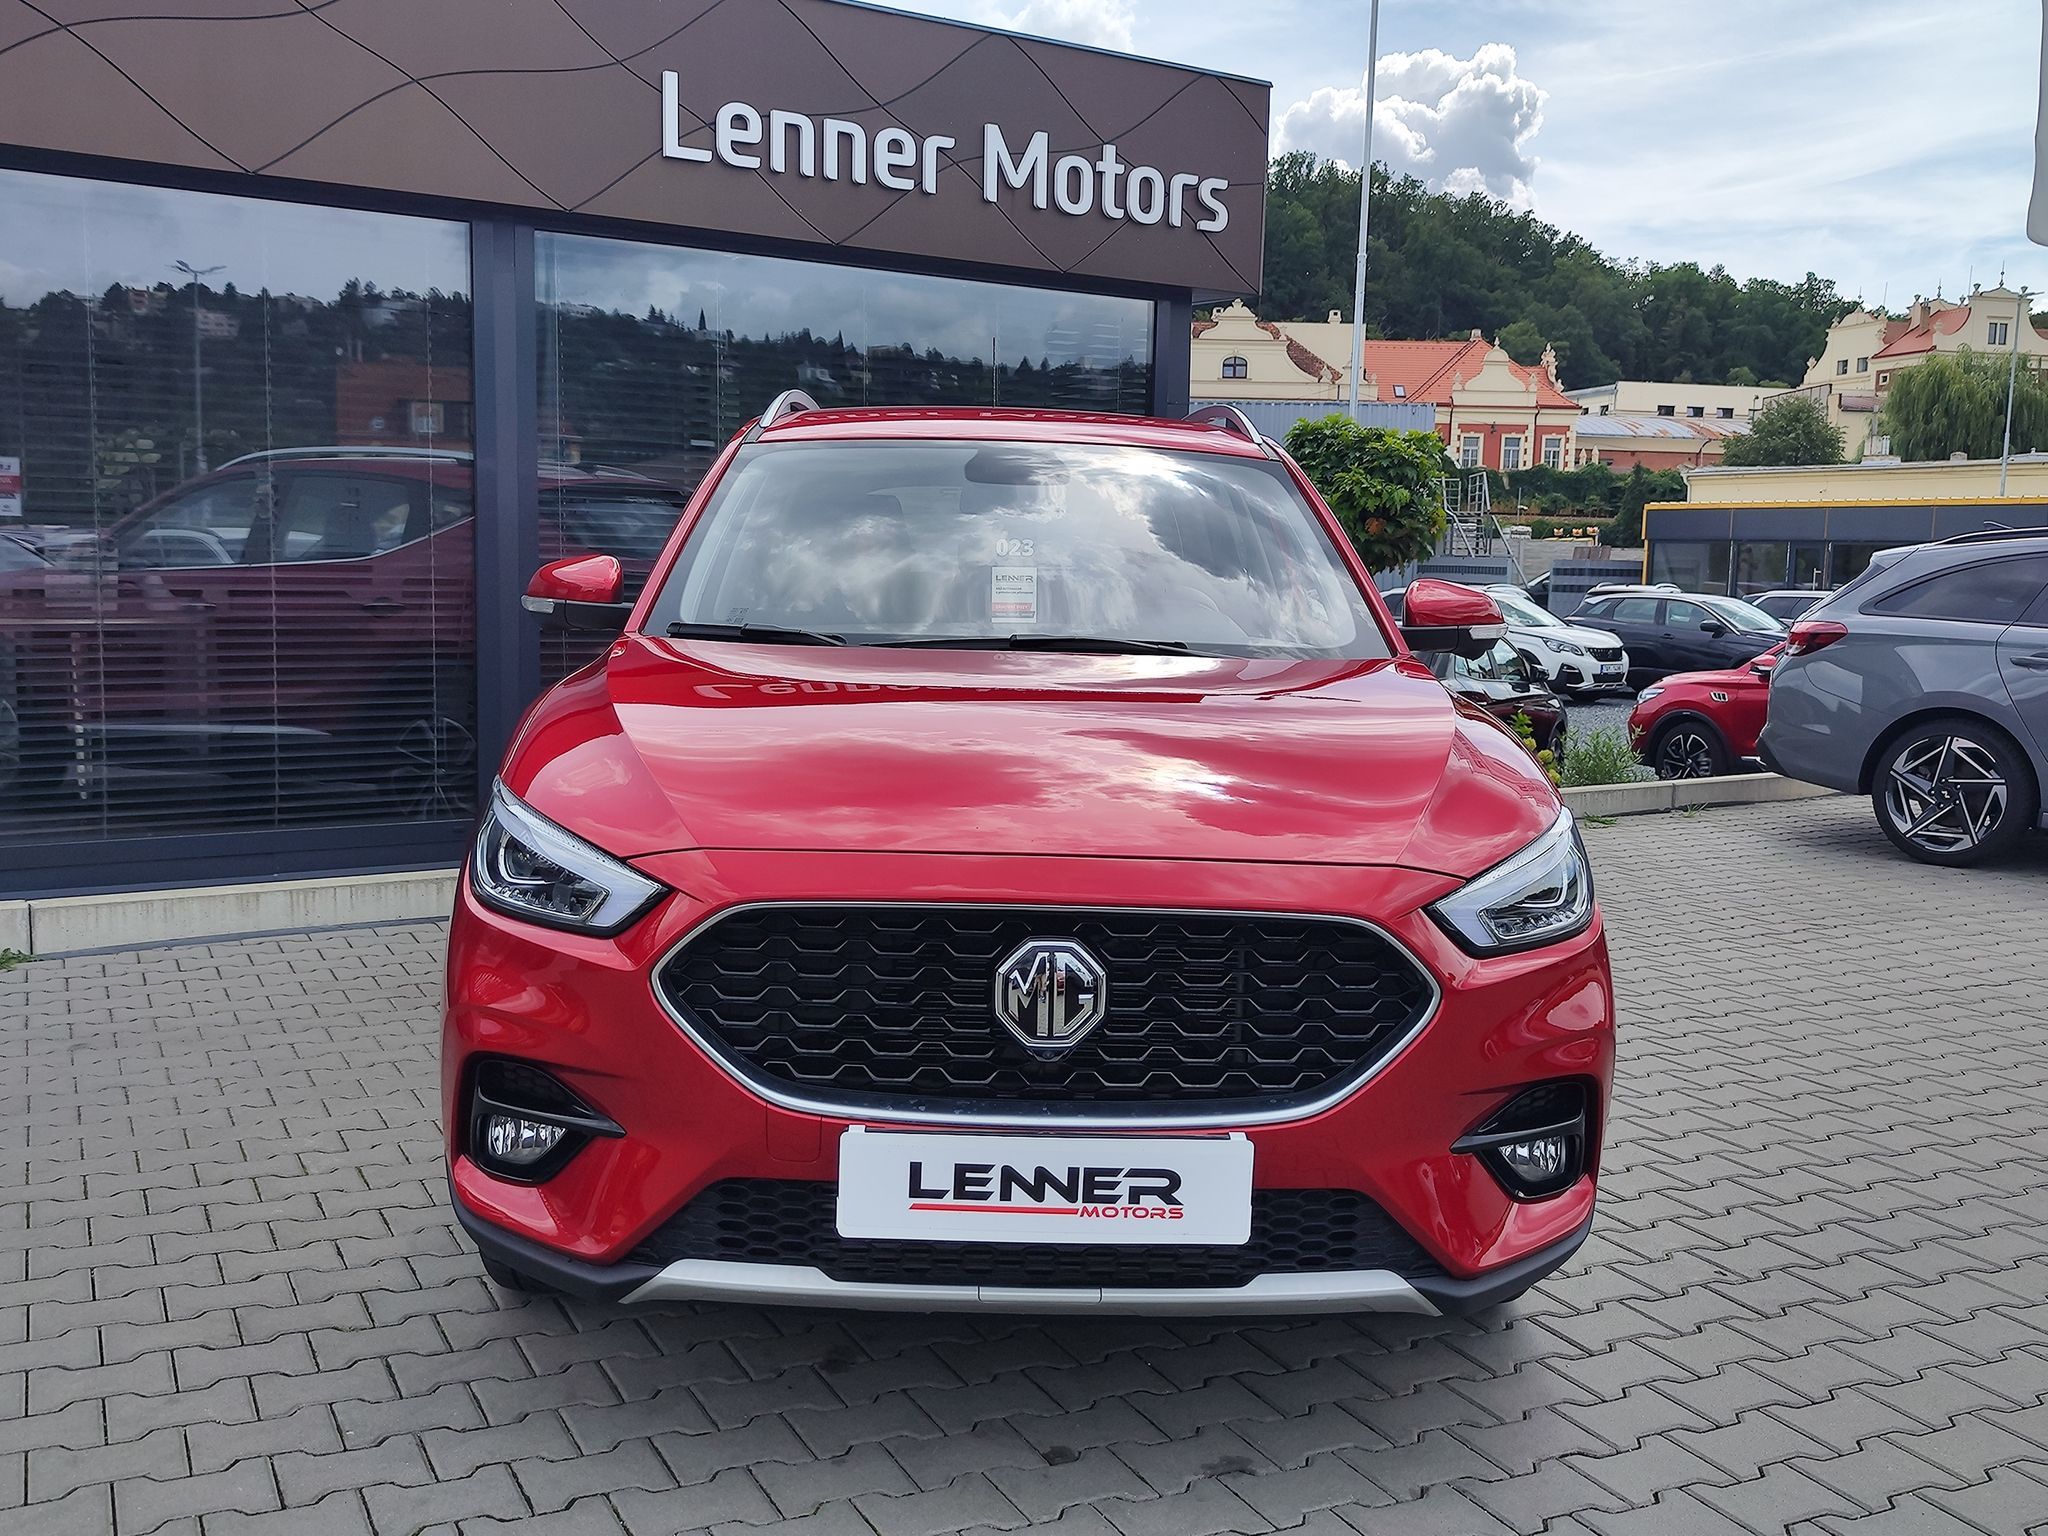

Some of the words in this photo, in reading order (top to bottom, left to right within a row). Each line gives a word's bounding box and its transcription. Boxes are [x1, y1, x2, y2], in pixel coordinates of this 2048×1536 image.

[662, 70, 956, 195] Lenner
[983, 123, 1230, 233] Motors
[995, 538, 1035, 557] 023
[1008, 952, 1094, 1037] MG
[908, 1161, 1183, 1206] LENNER
[1079, 1206, 1185, 1220] MOTORS
